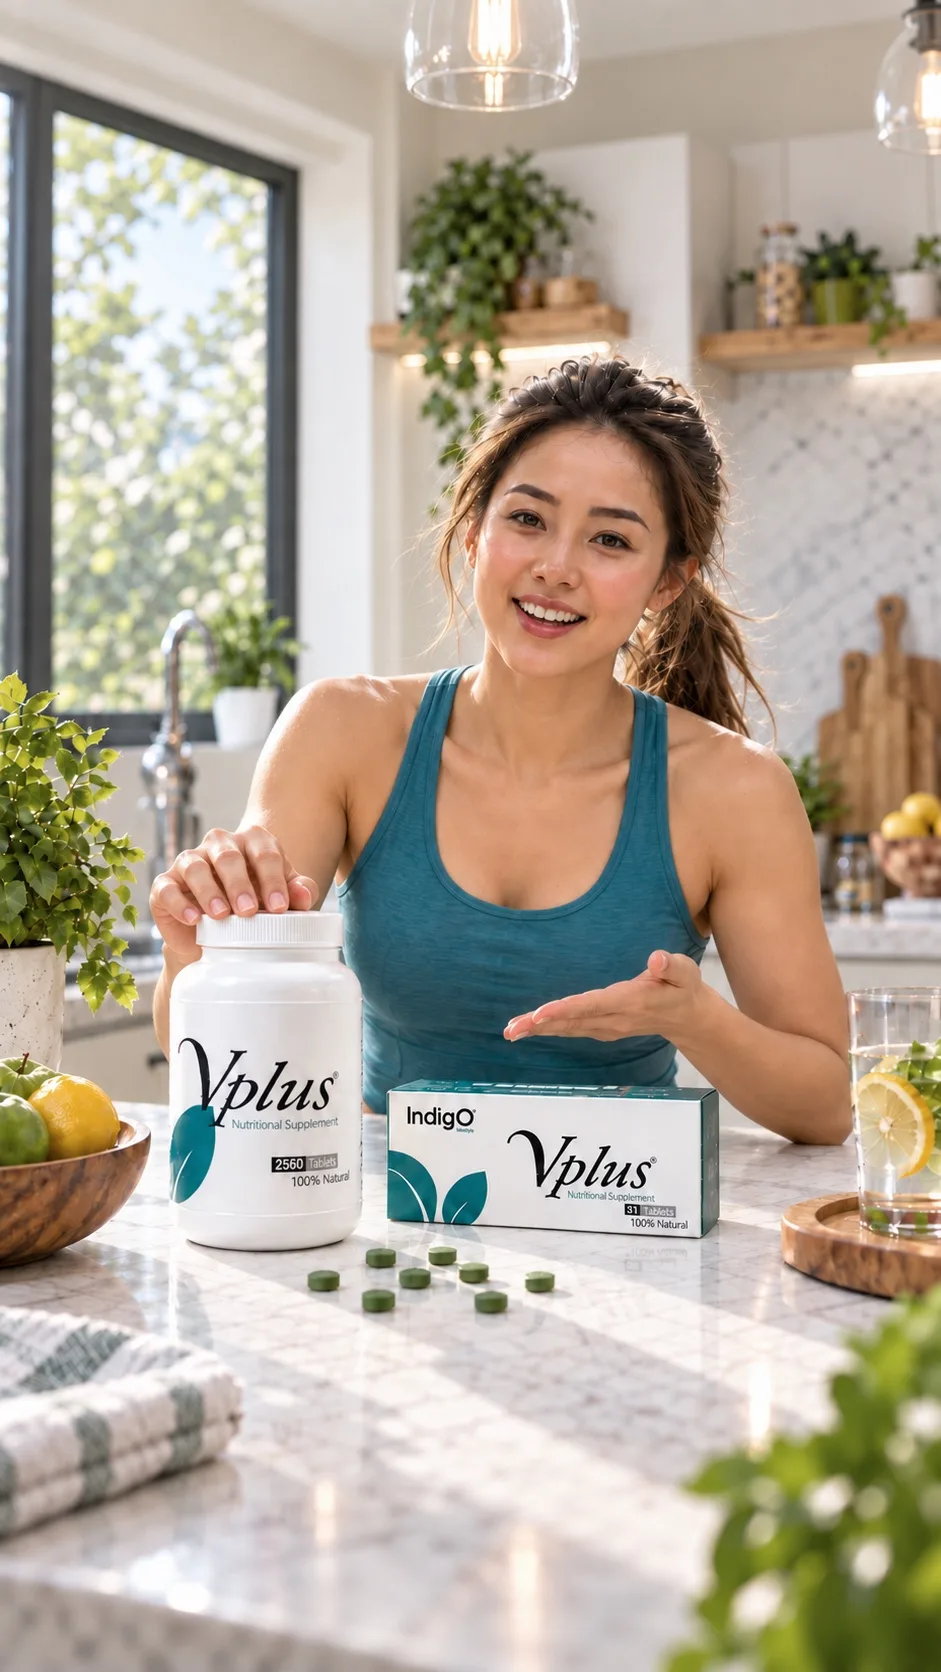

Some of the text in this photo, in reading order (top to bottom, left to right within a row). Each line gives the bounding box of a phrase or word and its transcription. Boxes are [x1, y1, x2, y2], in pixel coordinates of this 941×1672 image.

[231, 1117, 339, 1131] Nutritional Supplement
[275, 1156, 337, 1171] 2560 Tablets
[291, 1170, 350, 1187] 100% Natural
[567, 1190, 655, 1202] Nutritional Supplement
[626, 1205, 639, 1215] 31
[631, 1218, 689, 1229] 100% Natural
